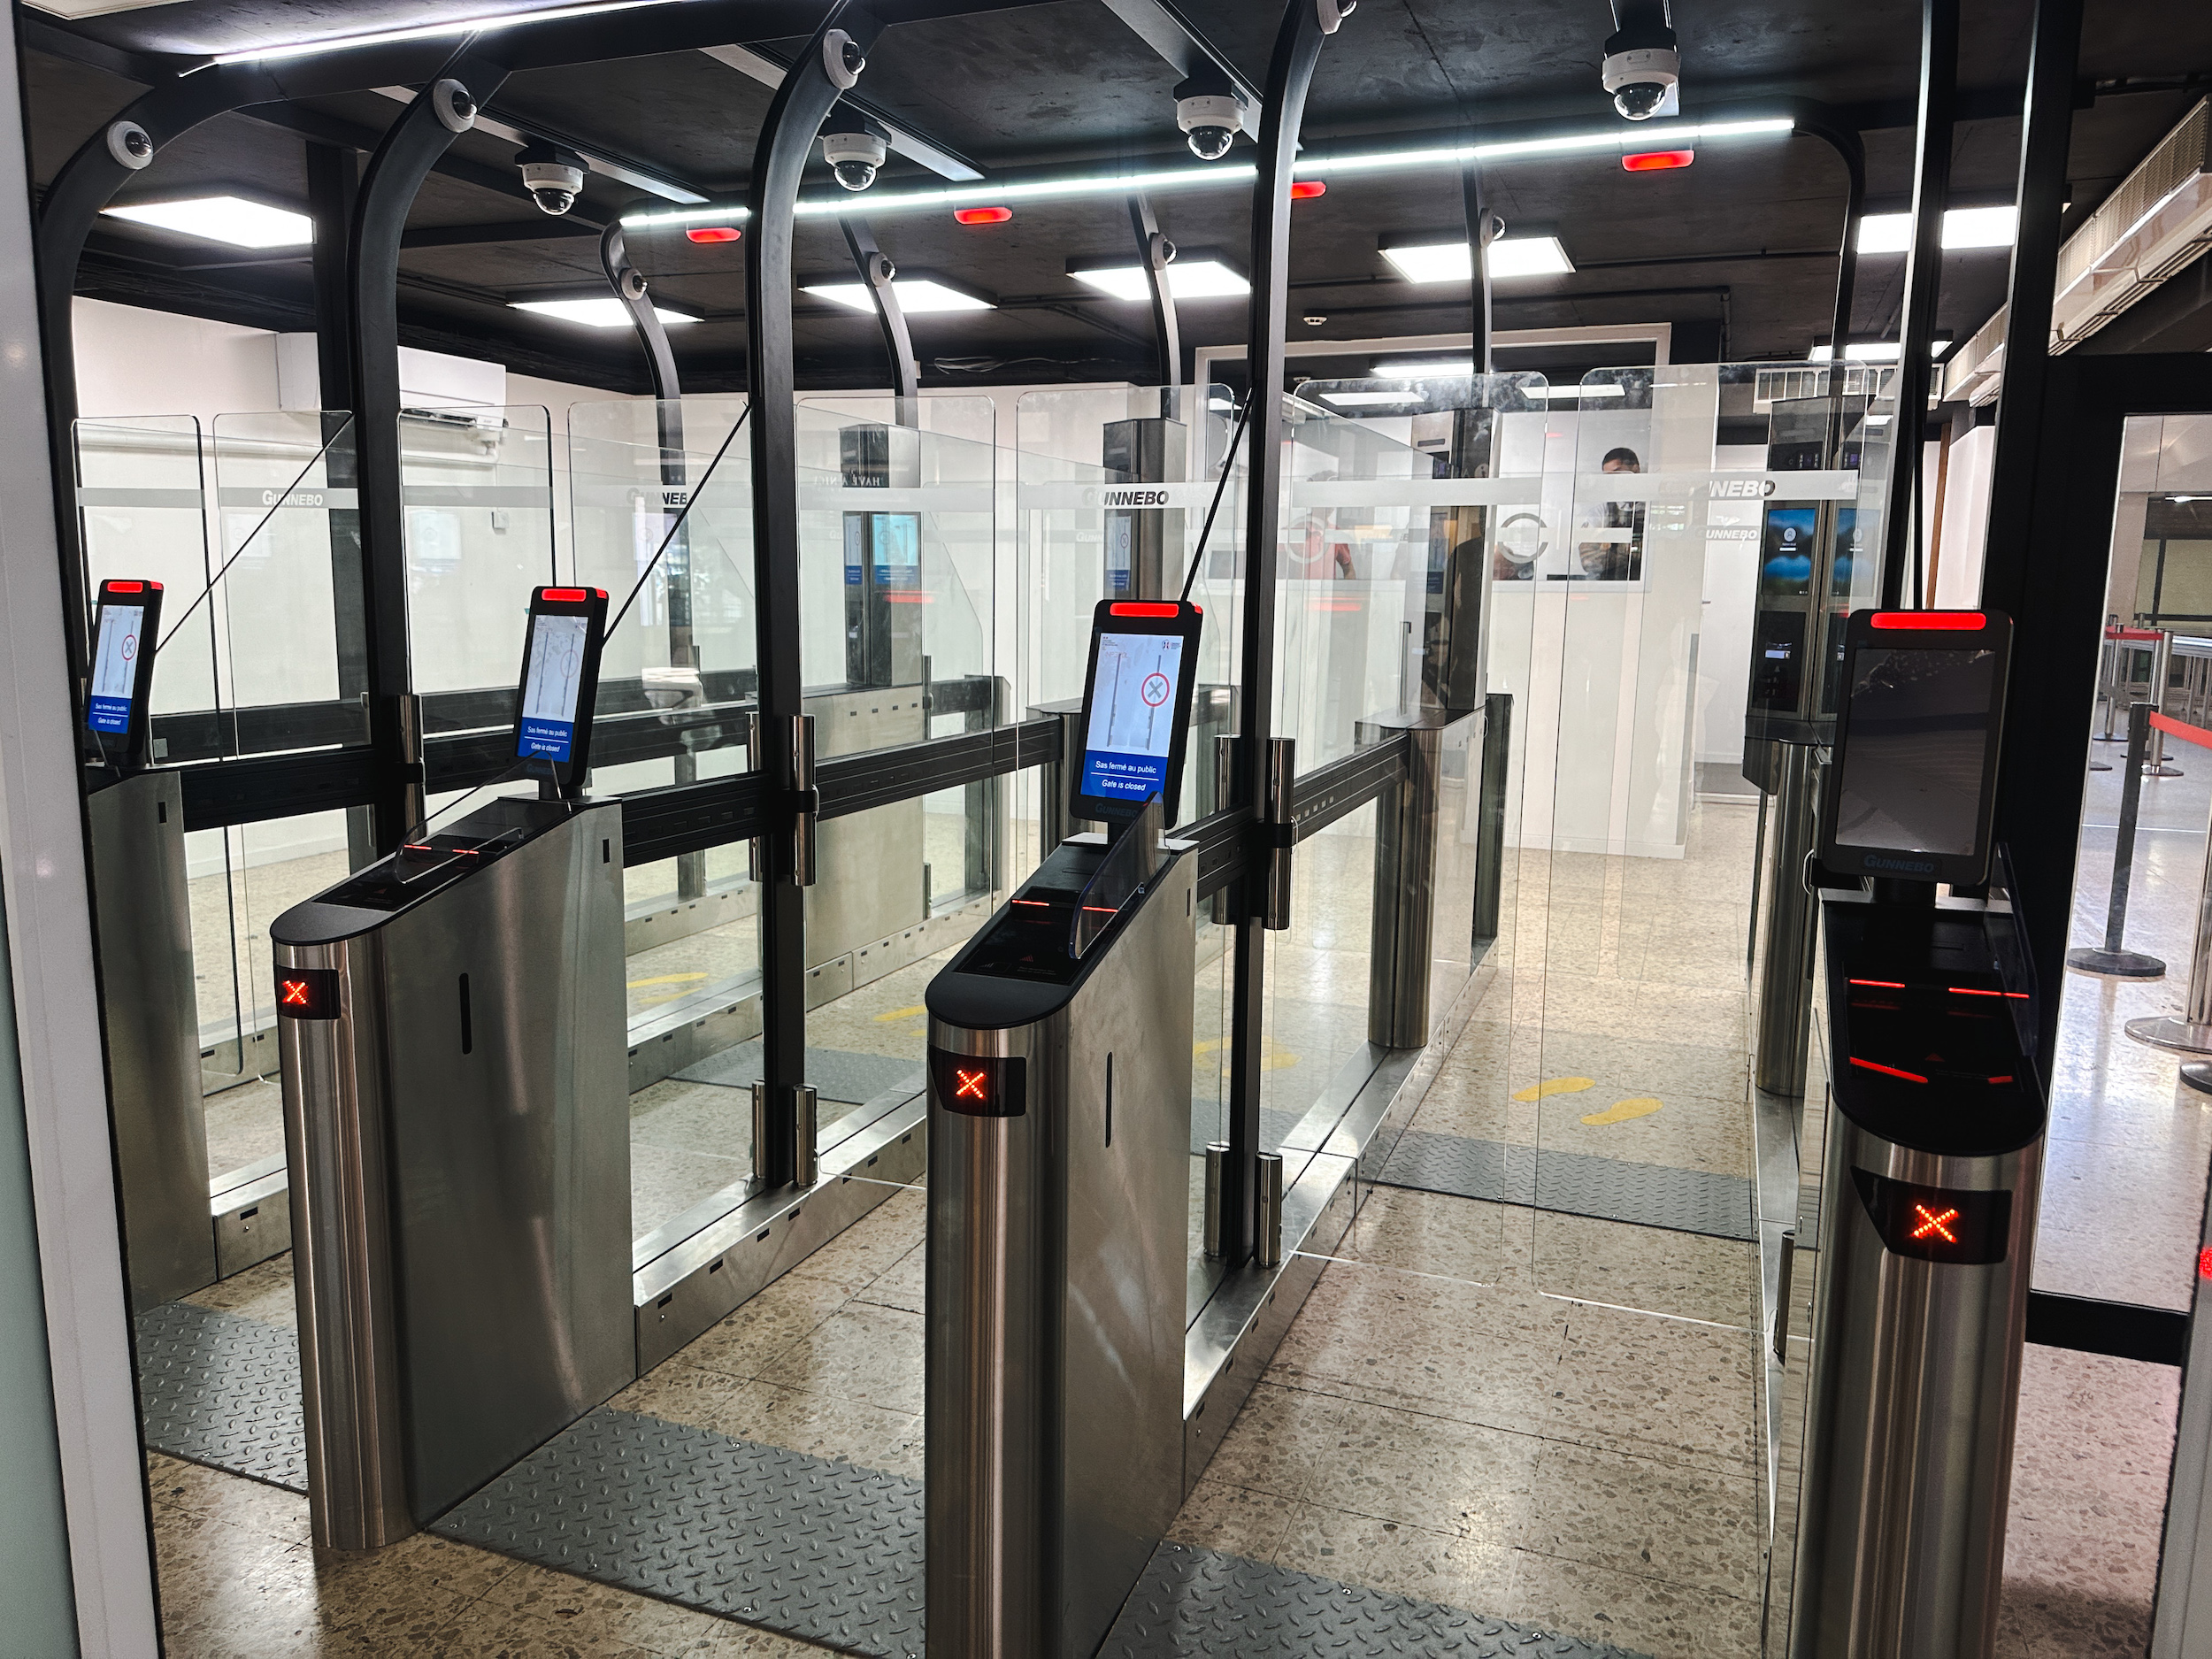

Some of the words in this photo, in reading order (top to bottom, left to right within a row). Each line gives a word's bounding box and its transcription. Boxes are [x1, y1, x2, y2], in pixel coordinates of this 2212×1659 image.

[262, 489, 324, 506] GUNNEBO
[1081, 487, 1170, 506] GUNNEBO
[1095, 760, 1108, 769] Sas
[1109, 762, 1127, 772] fermé
[1137, 765, 1157, 774] public
[1102, 779, 1118, 787] Gate
[1118, 780, 1125, 789] is
[1124, 782, 1147, 791] closed
[1863, 854, 1935, 872] GUNNEBO
